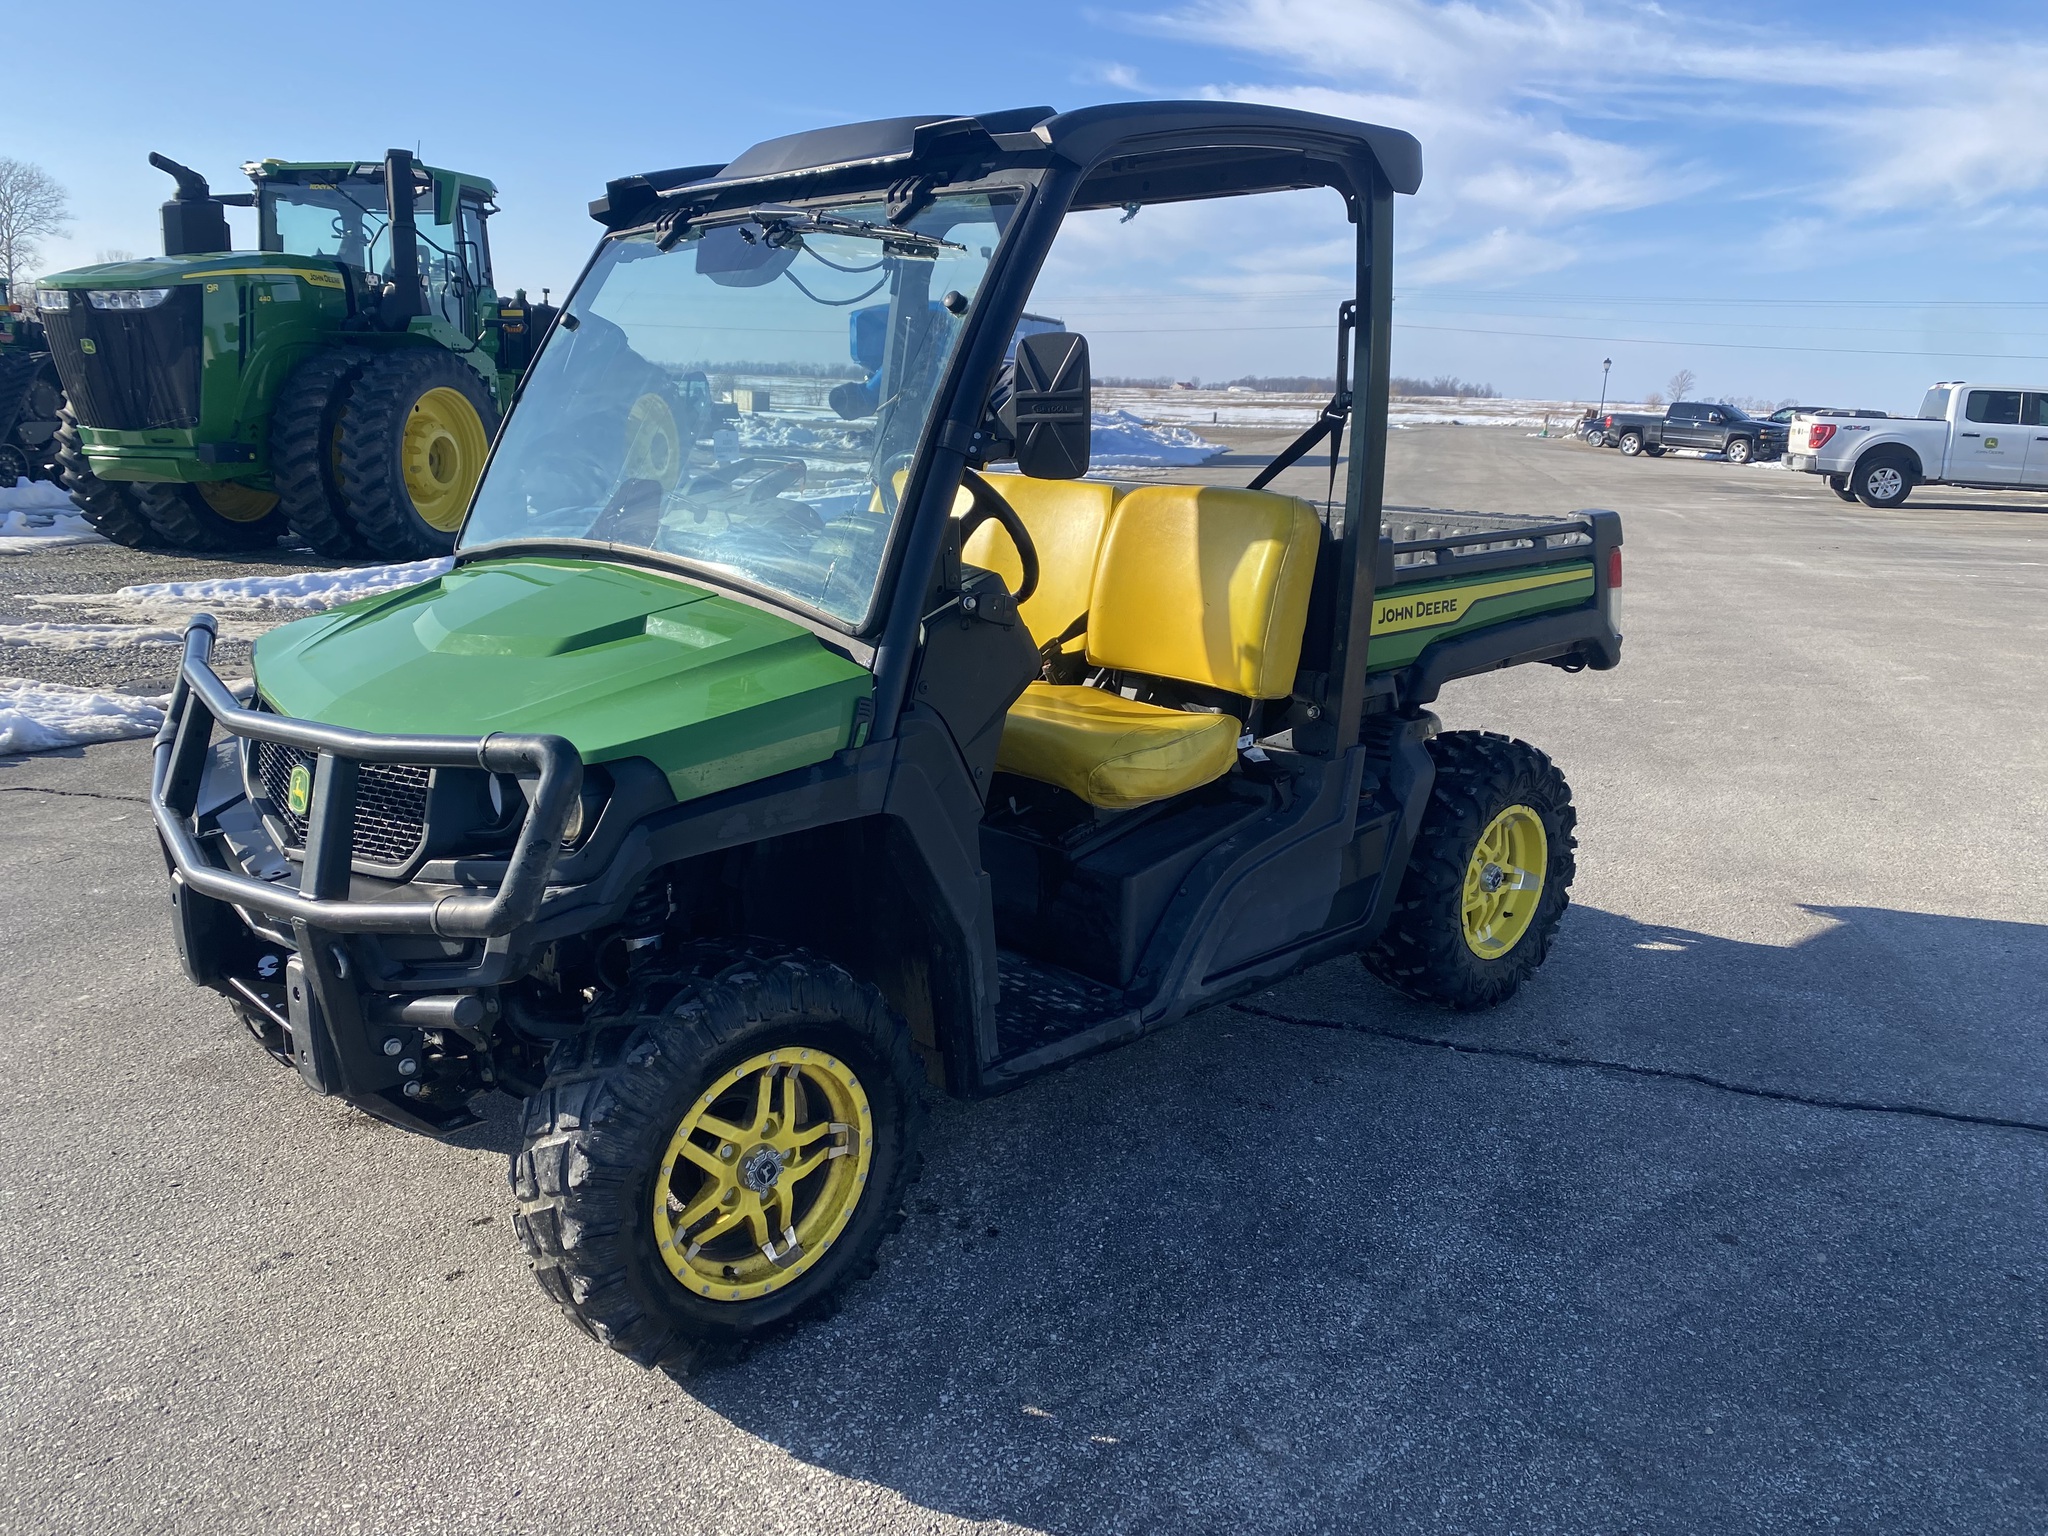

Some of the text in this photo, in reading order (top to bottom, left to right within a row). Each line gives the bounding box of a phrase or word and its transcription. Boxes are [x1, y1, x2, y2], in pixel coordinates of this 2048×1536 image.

[310, 273, 341, 284] JOHN DEERE
[206, 283, 219, 293] 9R
[1378, 598, 1457, 624] JOHN DEERE
